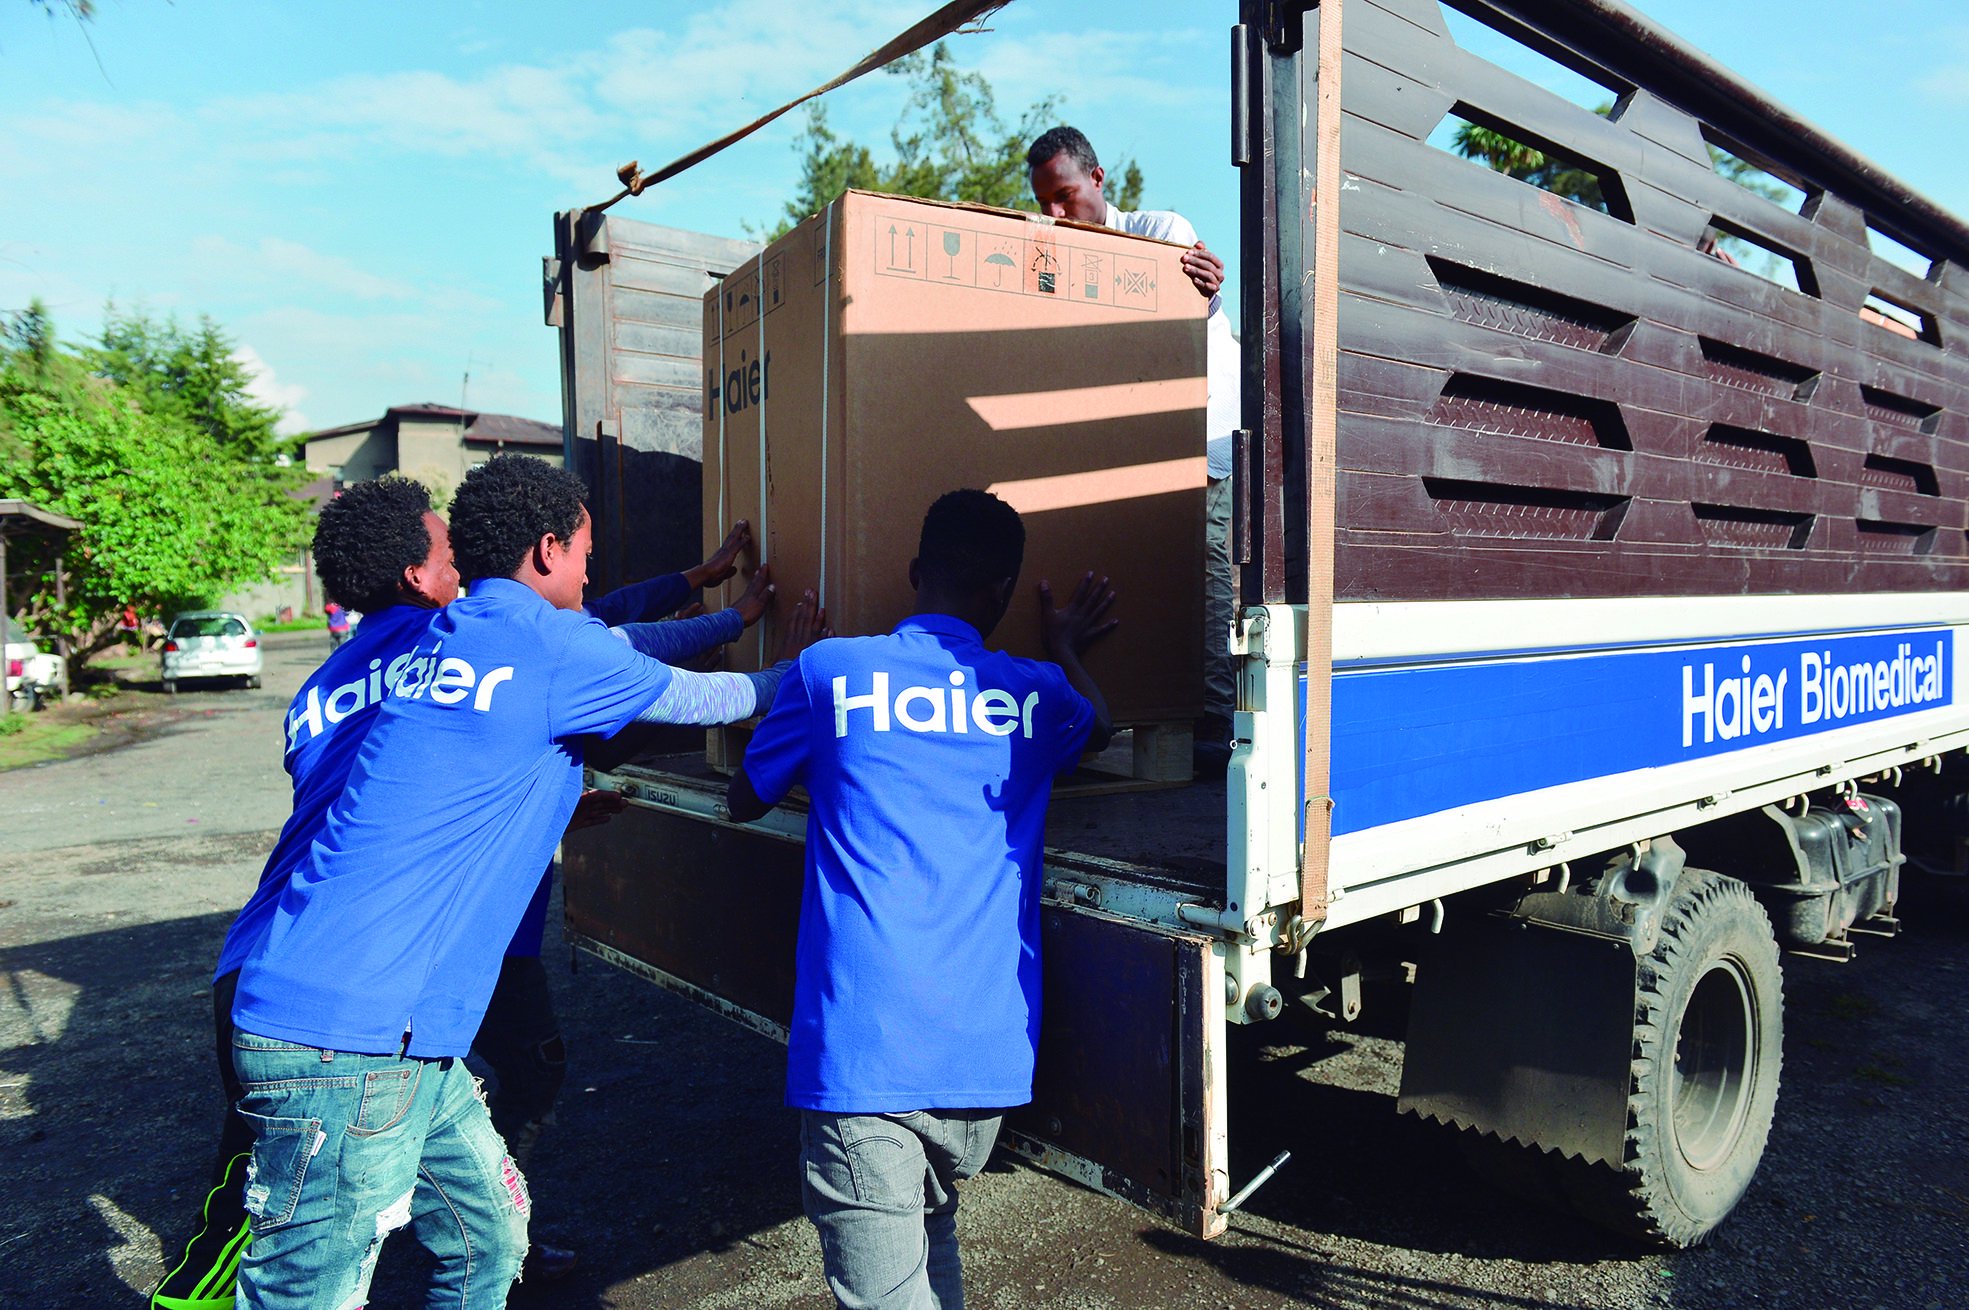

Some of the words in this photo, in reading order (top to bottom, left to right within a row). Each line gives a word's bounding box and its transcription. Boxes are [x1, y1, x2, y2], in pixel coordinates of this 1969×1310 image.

[709, 349, 770, 421] Haier
[832, 670, 1039, 739] Haier
[1682, 654, 1788, 748] Haier
[1801, 640, 1944, 725] Biomedical
[647, 789, 676, 806] ISUZU
